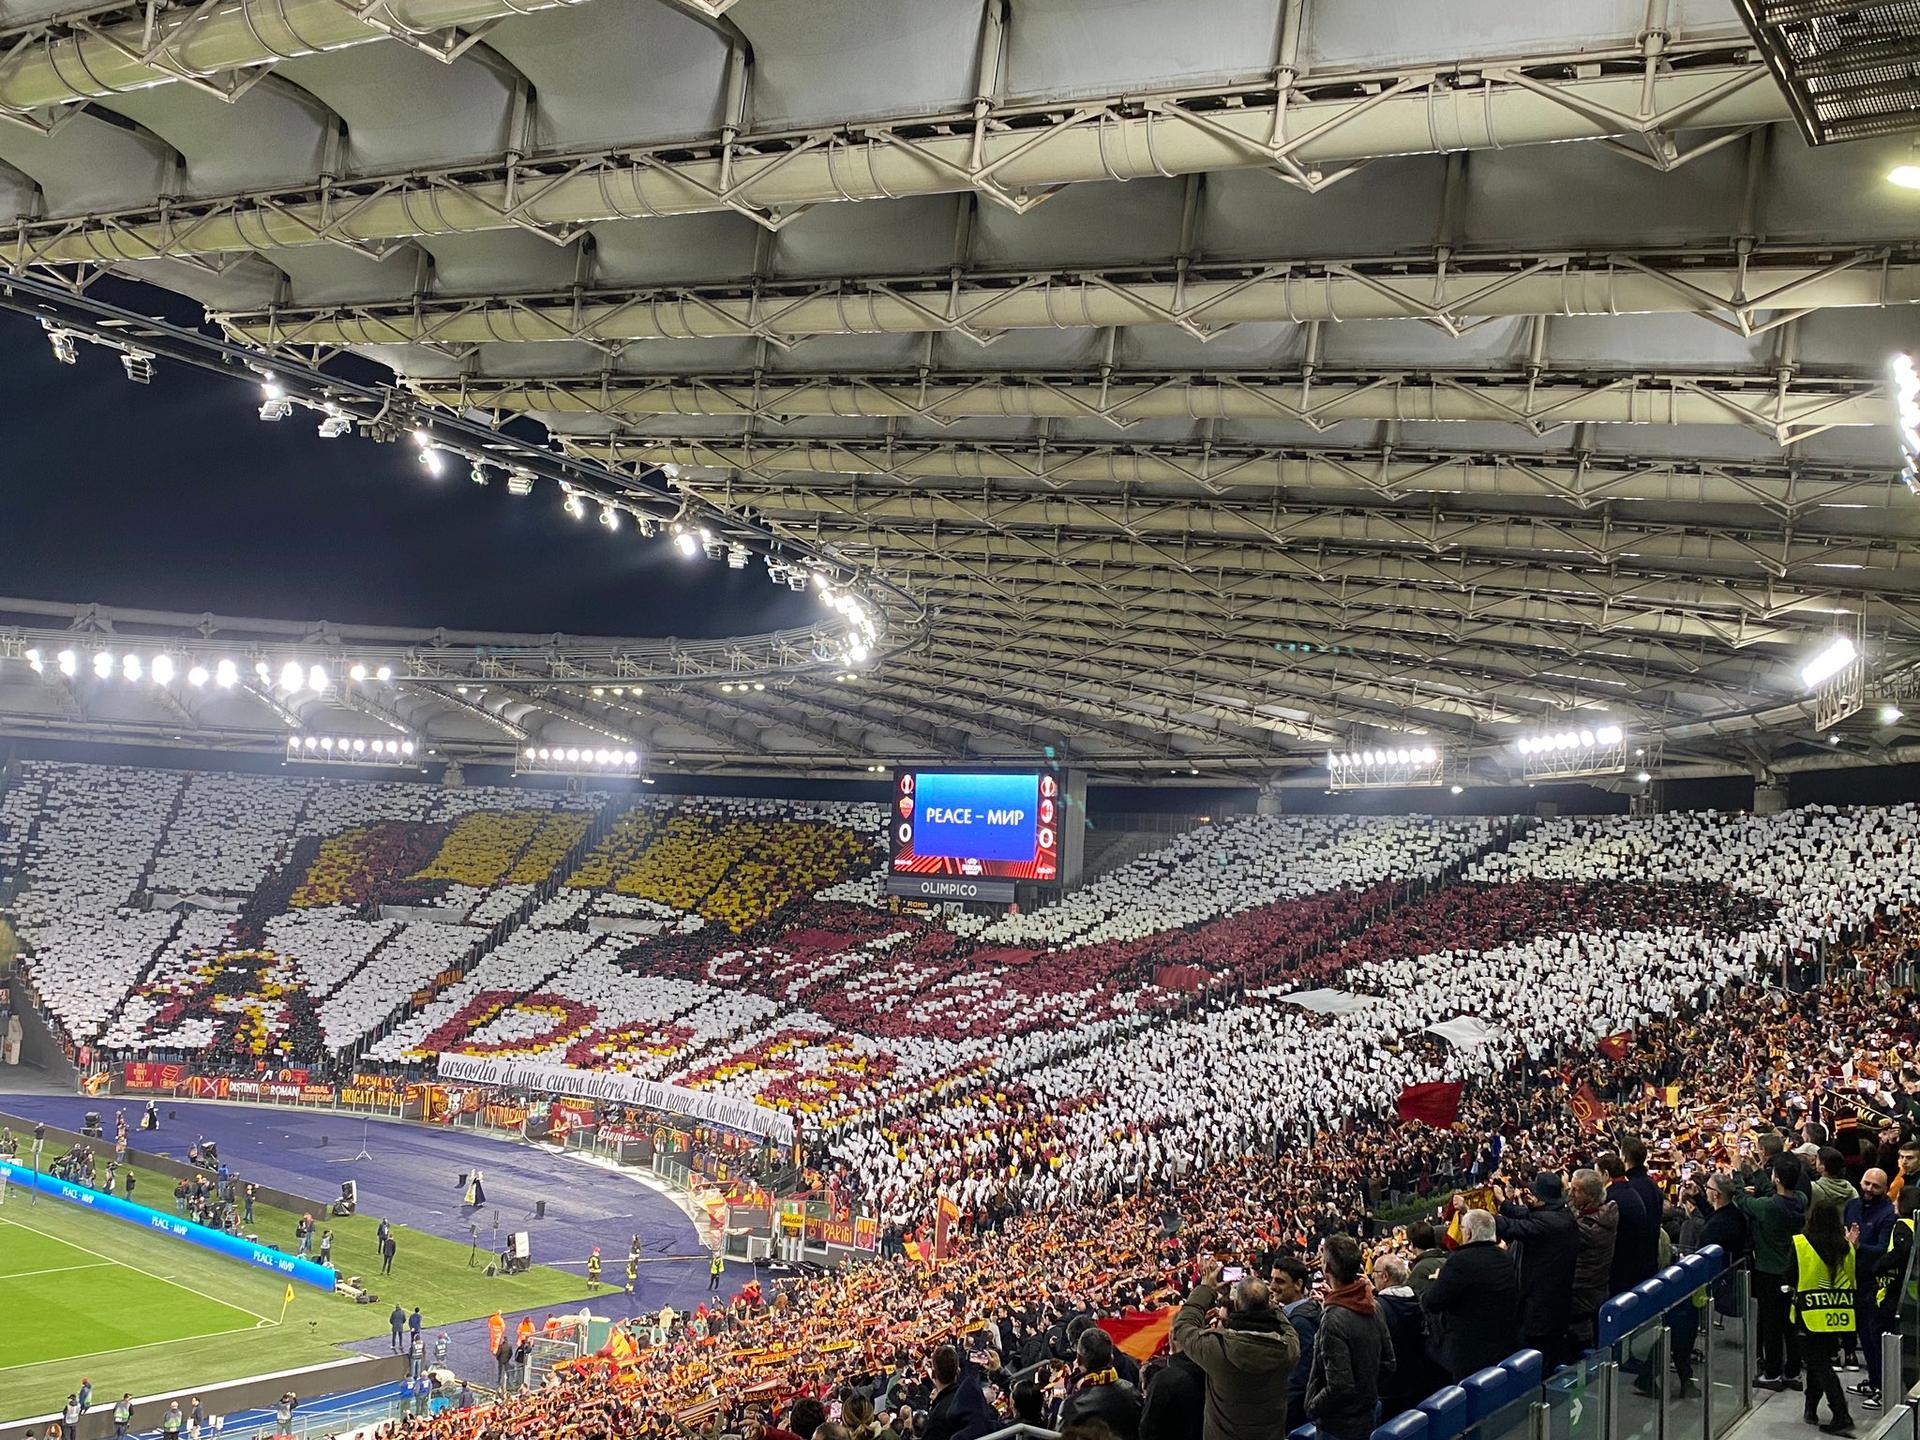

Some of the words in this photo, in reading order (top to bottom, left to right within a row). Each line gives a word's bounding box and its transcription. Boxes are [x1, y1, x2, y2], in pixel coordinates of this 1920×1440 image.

[926, 807, 971, 824] PEACE
[987, 809, 1024, 826] МИР
[899, 823, 912, 842] 0
[1039, 828, 1053, 848] 0
[921, 881, 977, 897] OLIMPICO
[229, 1081, 259, 1094] DISTINTI
[441, 1056, 497, 1082] orgoglio
[501, 1063, 517, 1084] di
[518, 1070, 544, 1089] una
[546, 1076, 584, 1094] curva
[632, 1080, 642, 1100] il
[645, 1083, 664, 1106] tuo
[665, 1091, 693, 1113] nome
[706, 1096, 716, 1120] la
[718, 1101, 751, 1129] nostra
[341, 1088, 375, 1105] BRIGATA
[62, 1186, 78, 1199] PEACE
[151, 1215, 170, 1230] PEACE
[856, 1220, 875, 1235] AVE
[253, 1250, 273, 1266] PEACE
[1805, 1292, 1853, 1307] STEWA
[1826, 1312, 1849, 1327] 209
